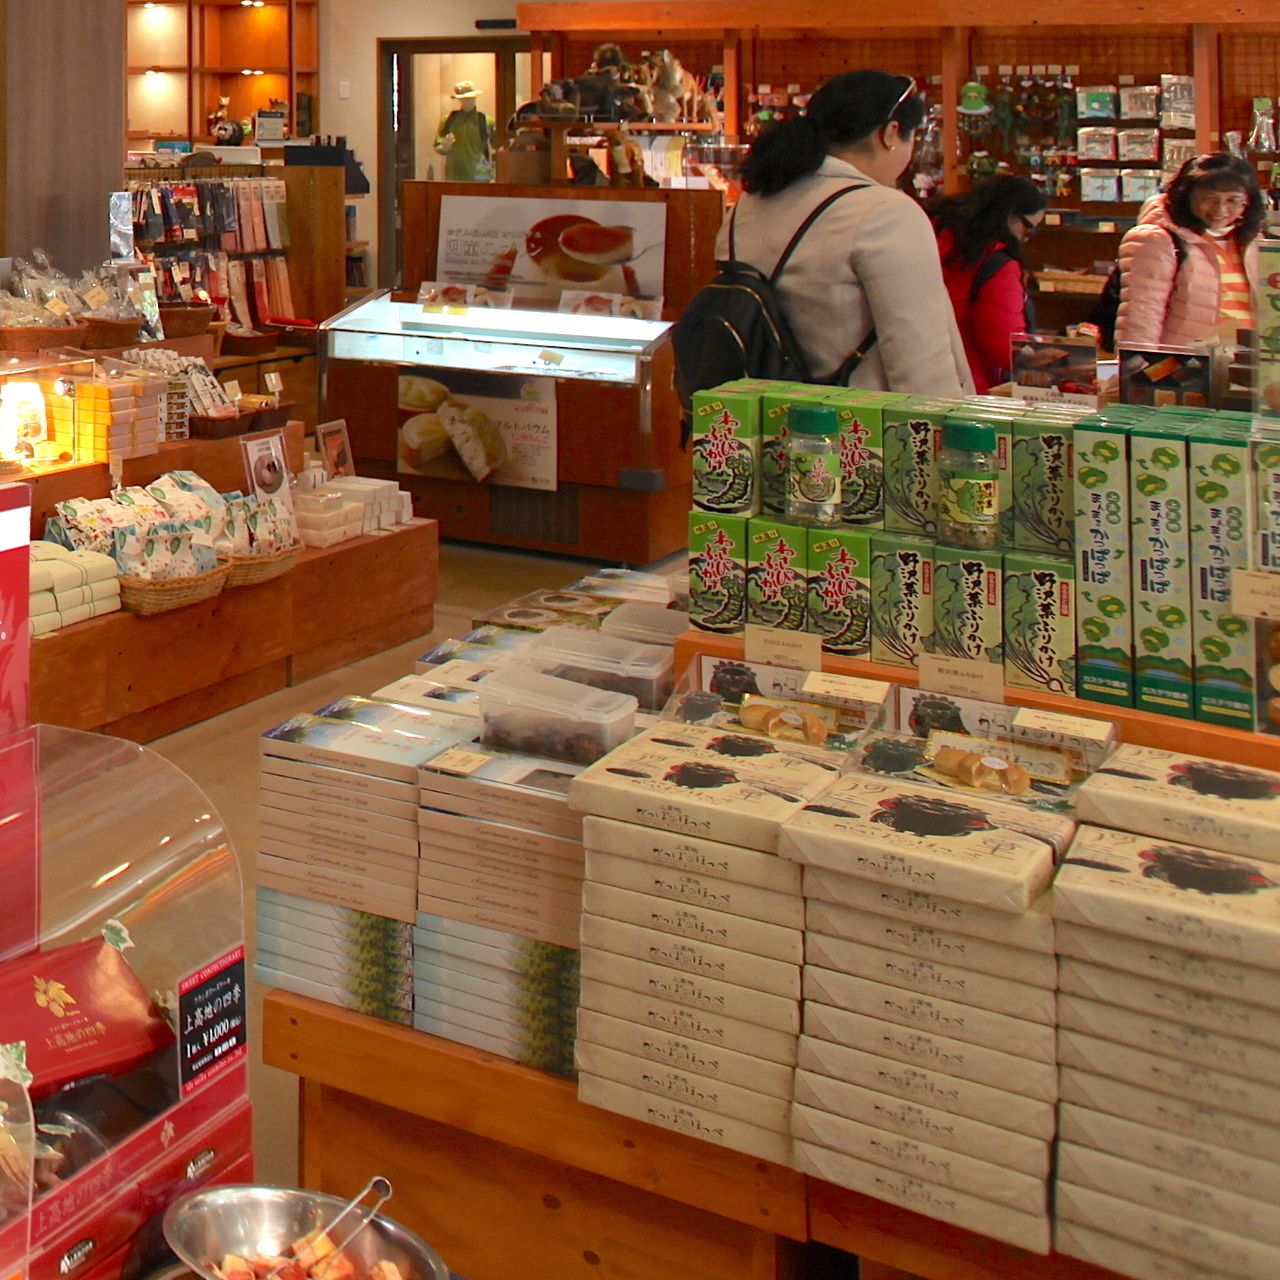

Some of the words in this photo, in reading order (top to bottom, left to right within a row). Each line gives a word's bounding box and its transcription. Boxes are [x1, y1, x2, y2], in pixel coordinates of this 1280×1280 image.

[908, 420, 931, 512] 野沢菜ふりかけ
[1040, 434, 1066, 529] 野沢菜ふりかけ
[699, 543, 719, 591] ふりかけ
[708, 529, 736, 578] わさび
[759, 553, 780, 600] ふりかけ
[768, 538, 796, 587] わさび
[831, 548, 859, 597] わさび
[820, 562, 842, 611] ふりかけ
[897, 551, 920, 645] 野沢菜ふりかけ
[961, 561, 984, 656] 野沢菜ふりかけ
[1033, 571, 1057, 667] 野沢菜ふりかけ
[184, 983, 242, 1035] 上高地の四季
